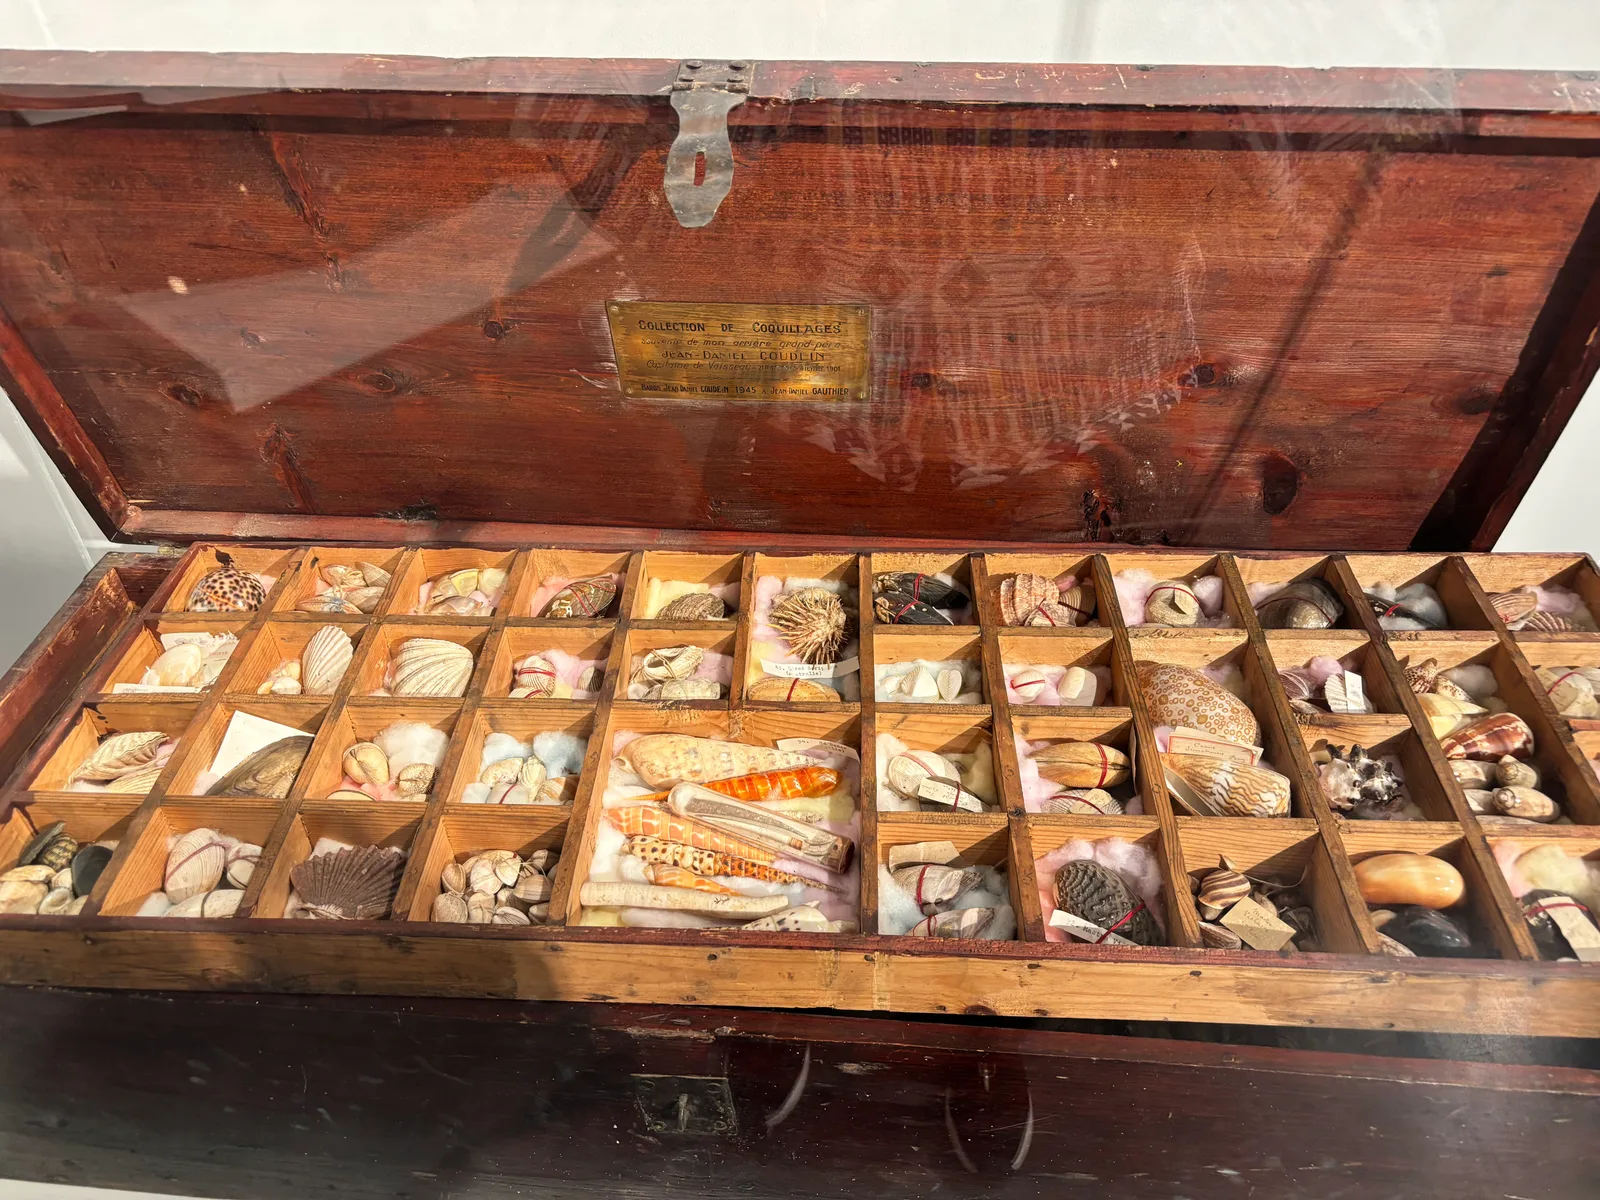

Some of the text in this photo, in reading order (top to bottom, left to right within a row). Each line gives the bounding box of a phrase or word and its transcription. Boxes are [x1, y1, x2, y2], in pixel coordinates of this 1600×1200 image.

[638, 319, 841, 334] COLLECTION DE COQUILLAGES
[687, 337, 698, 346] de
[703, 339, 725, 347] mon
[646, 360, 688, 371] Capitaine
[693, 361, 704, 369] de
[708, 361, 751, 372] Vaisseau
[735, 386, 756, 394] 1945
[812, 387, 849, 396] GAUTHIER
